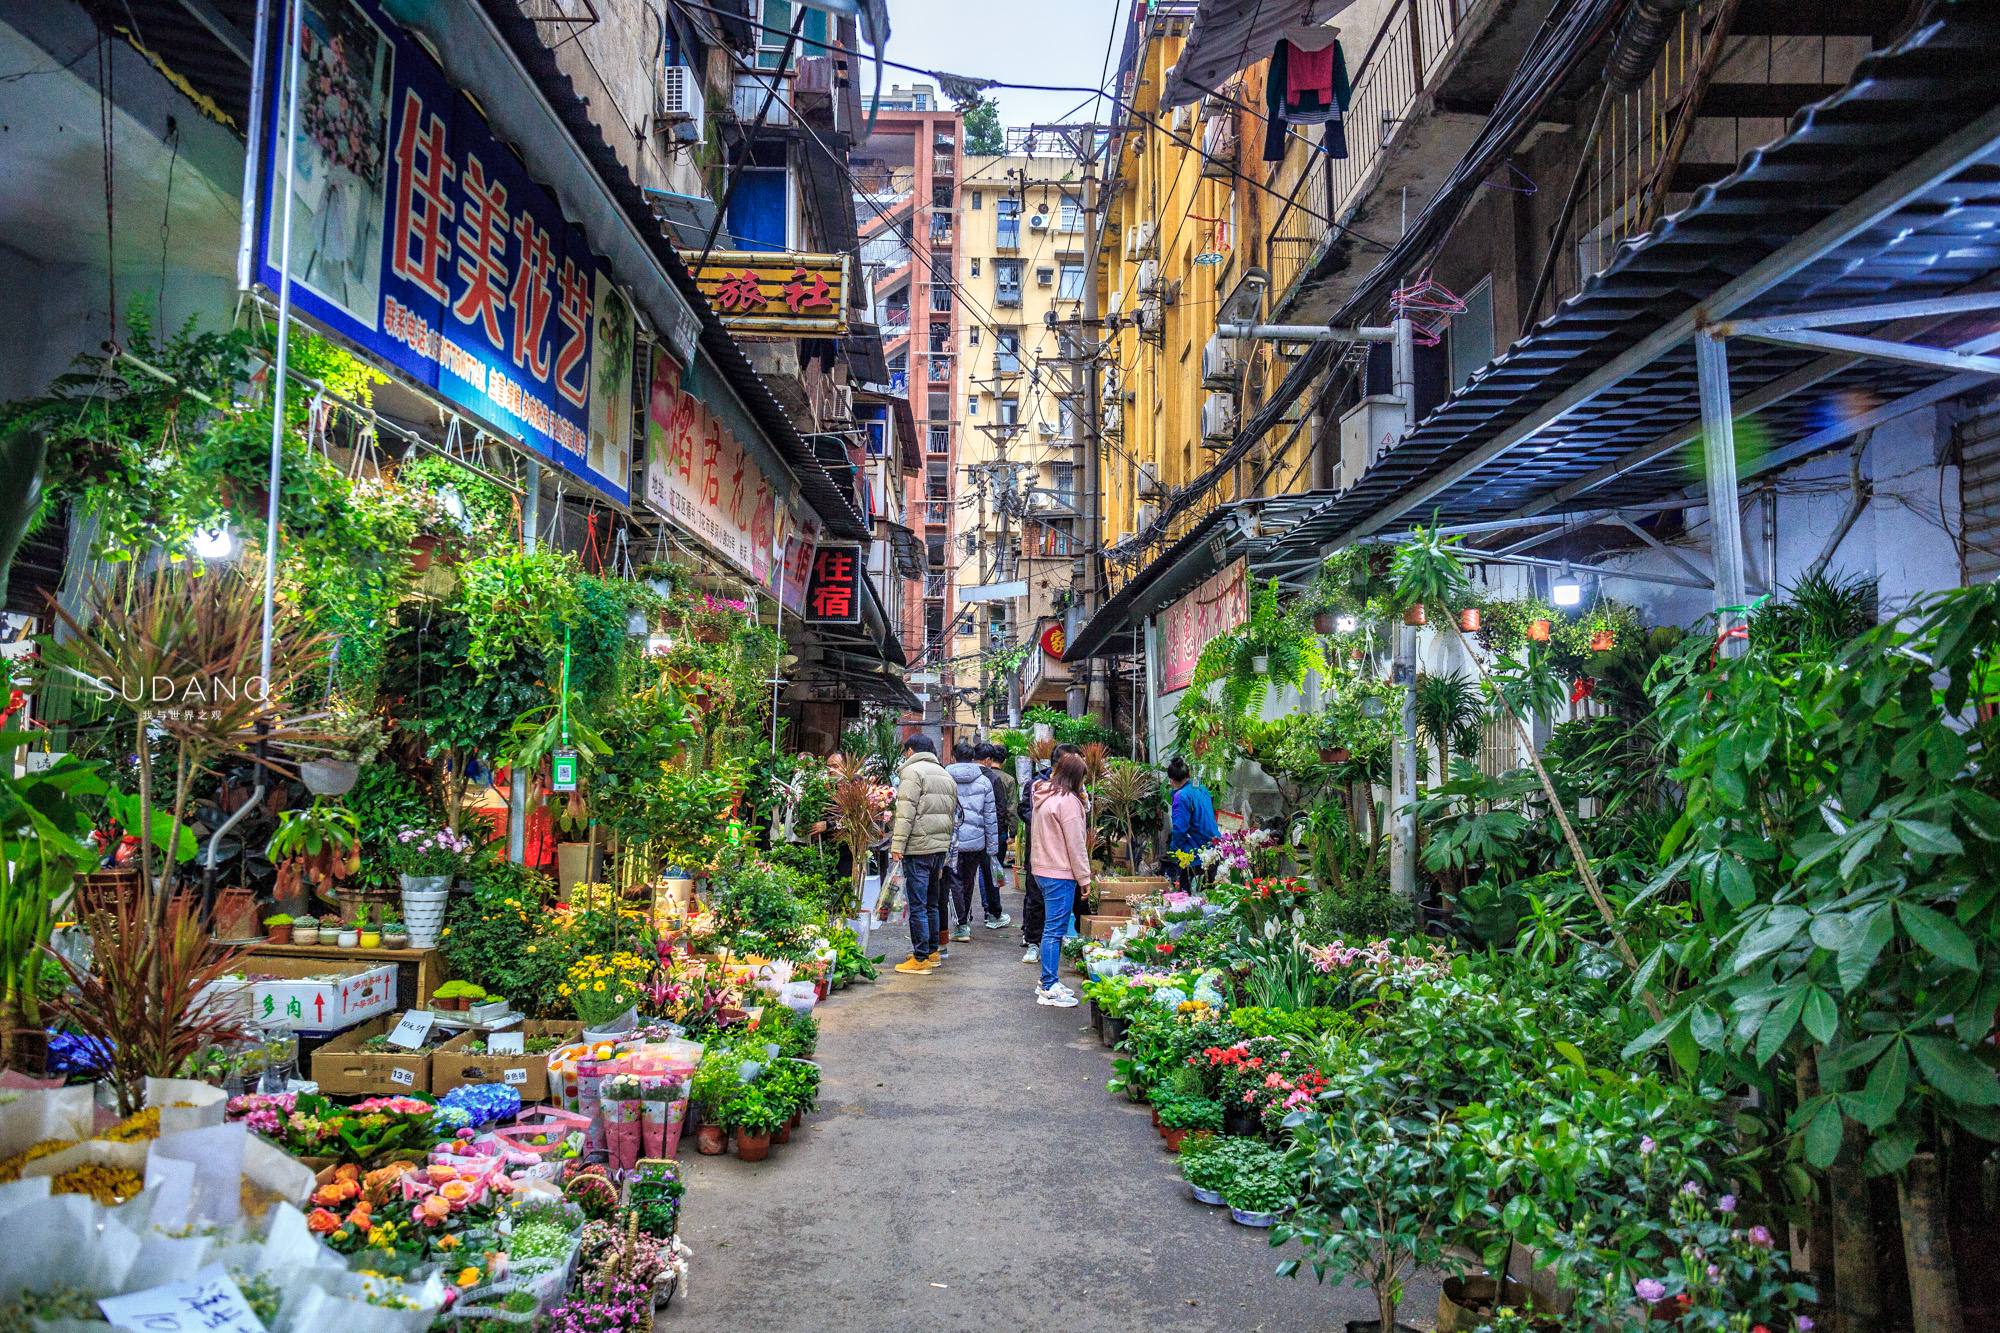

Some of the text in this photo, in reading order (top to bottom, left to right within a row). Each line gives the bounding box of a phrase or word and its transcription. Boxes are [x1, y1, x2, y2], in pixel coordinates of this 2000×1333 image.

[392, 87, 592, 408] 佳美花艺
[688, 267, 833, 312] 旅社
[812, 551, 853, 616] 住宿
[260, 994, 301, 1019] 多肉
